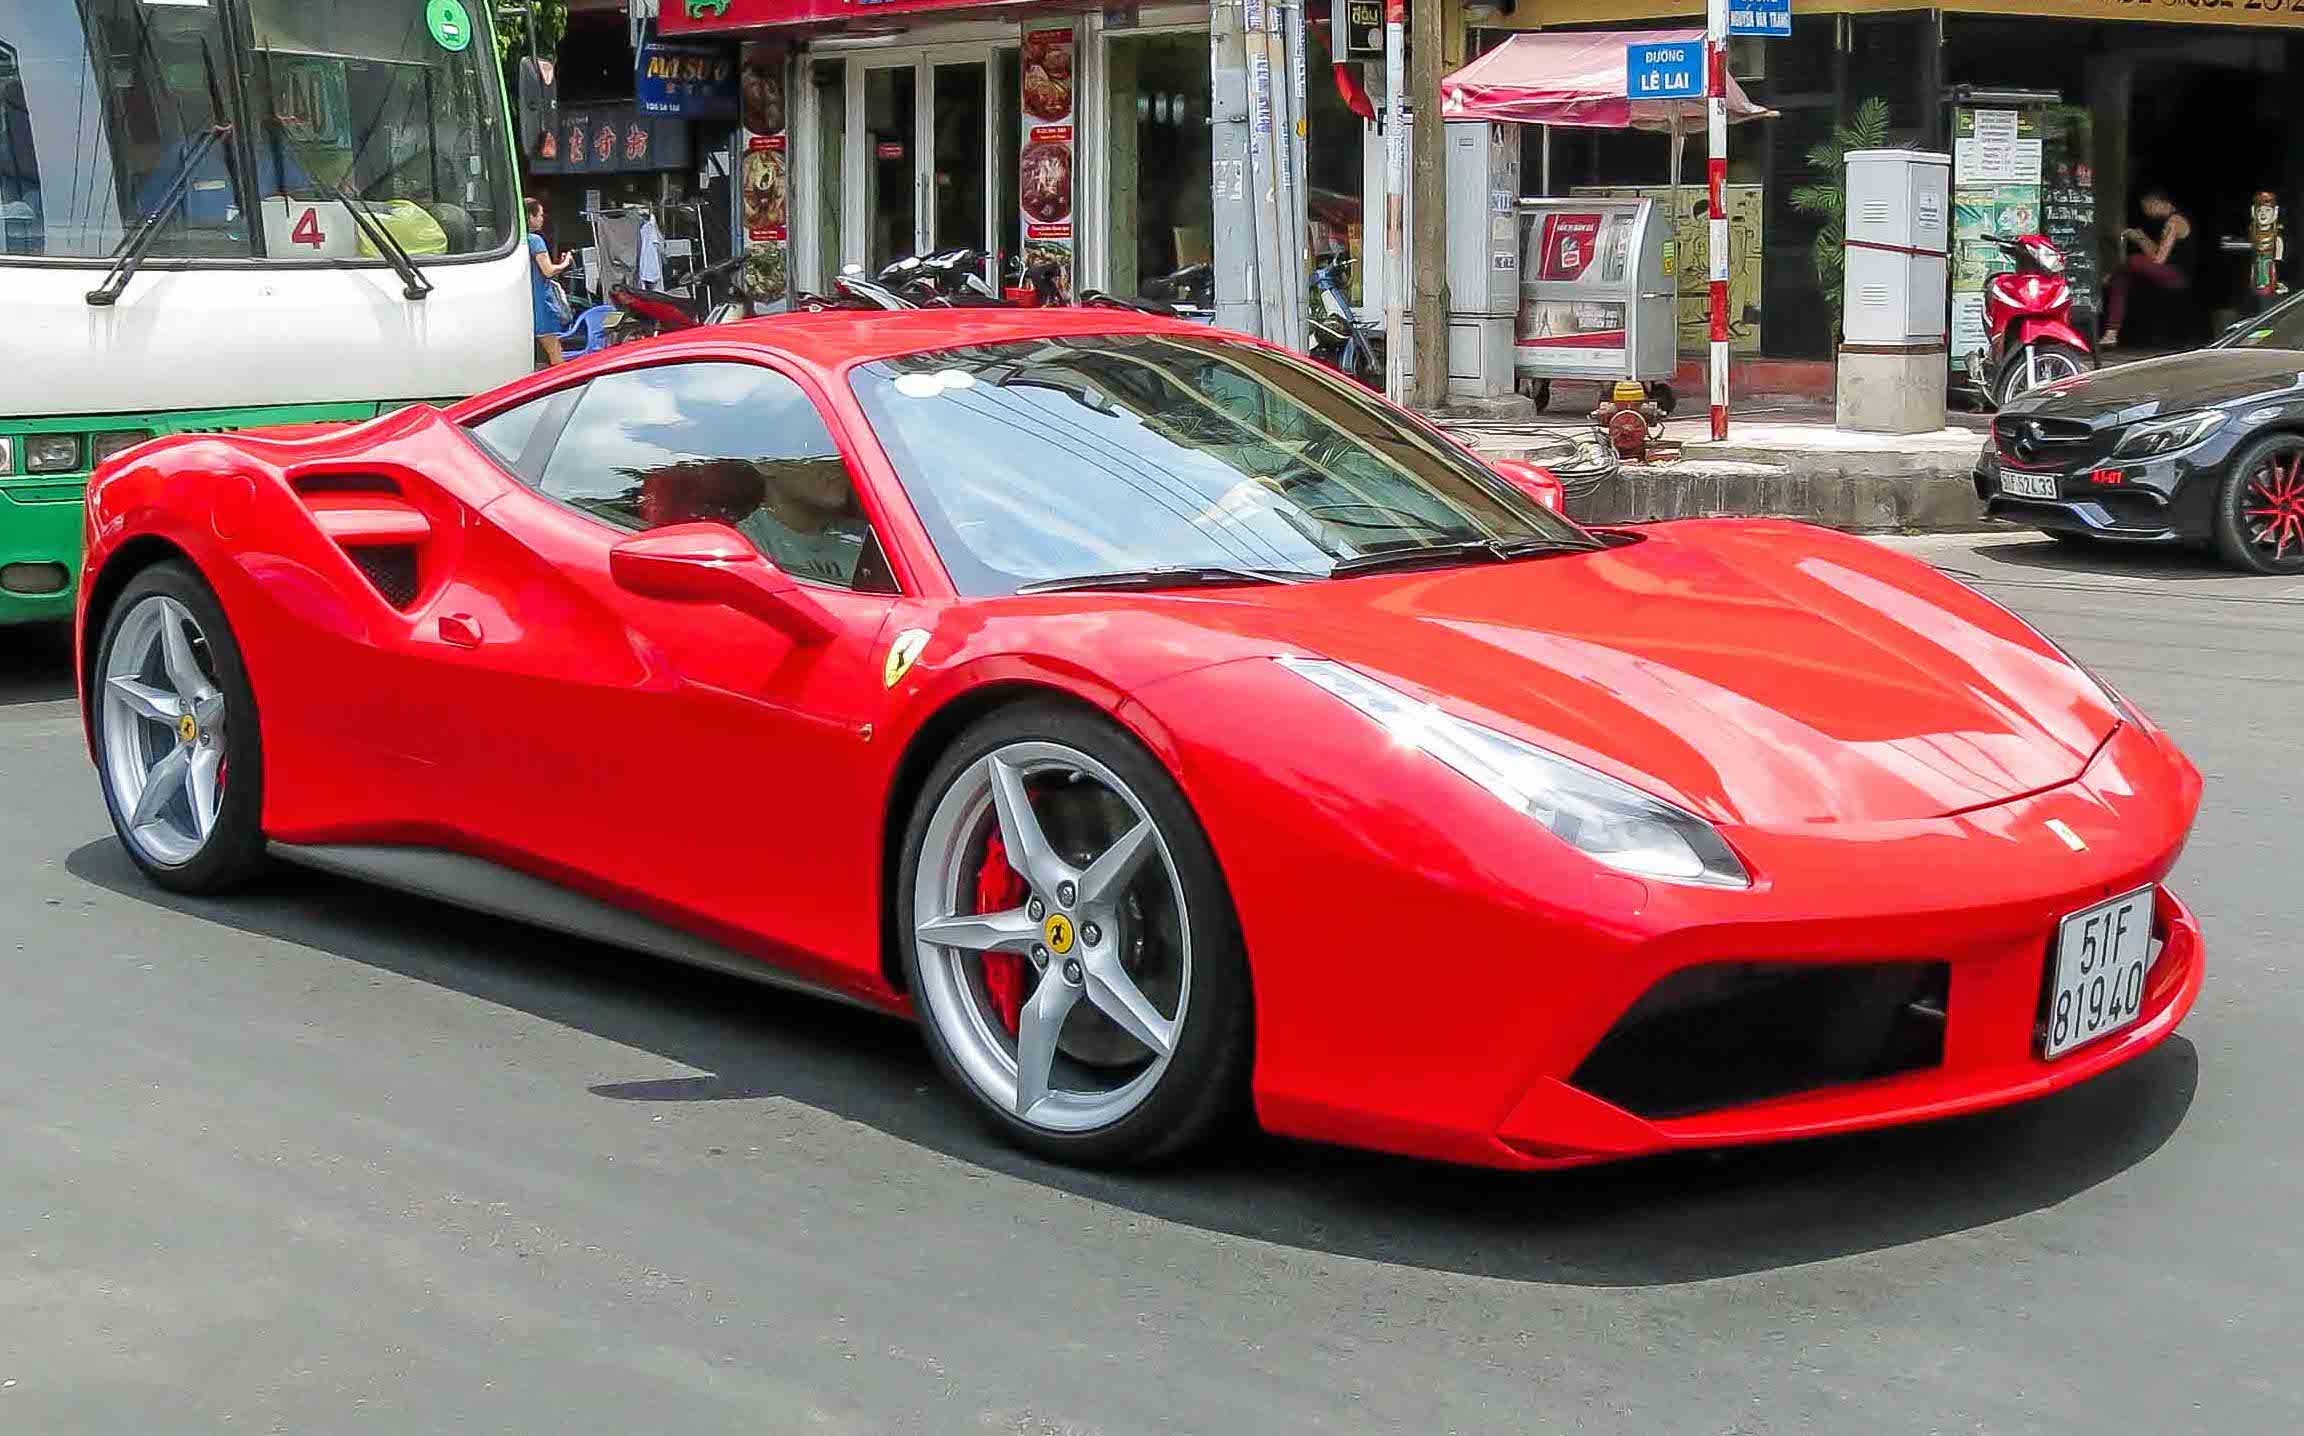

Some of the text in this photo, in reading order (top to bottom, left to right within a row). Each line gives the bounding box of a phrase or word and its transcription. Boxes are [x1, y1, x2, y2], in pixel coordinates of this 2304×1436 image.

[1645, 48, 1685, 63] ĐƯỜNG
[1641, 69, 1689, 91] LÊ LAI
[291, 207, 325, 249] 4
[2080, 905, 2133, 975] 51F
